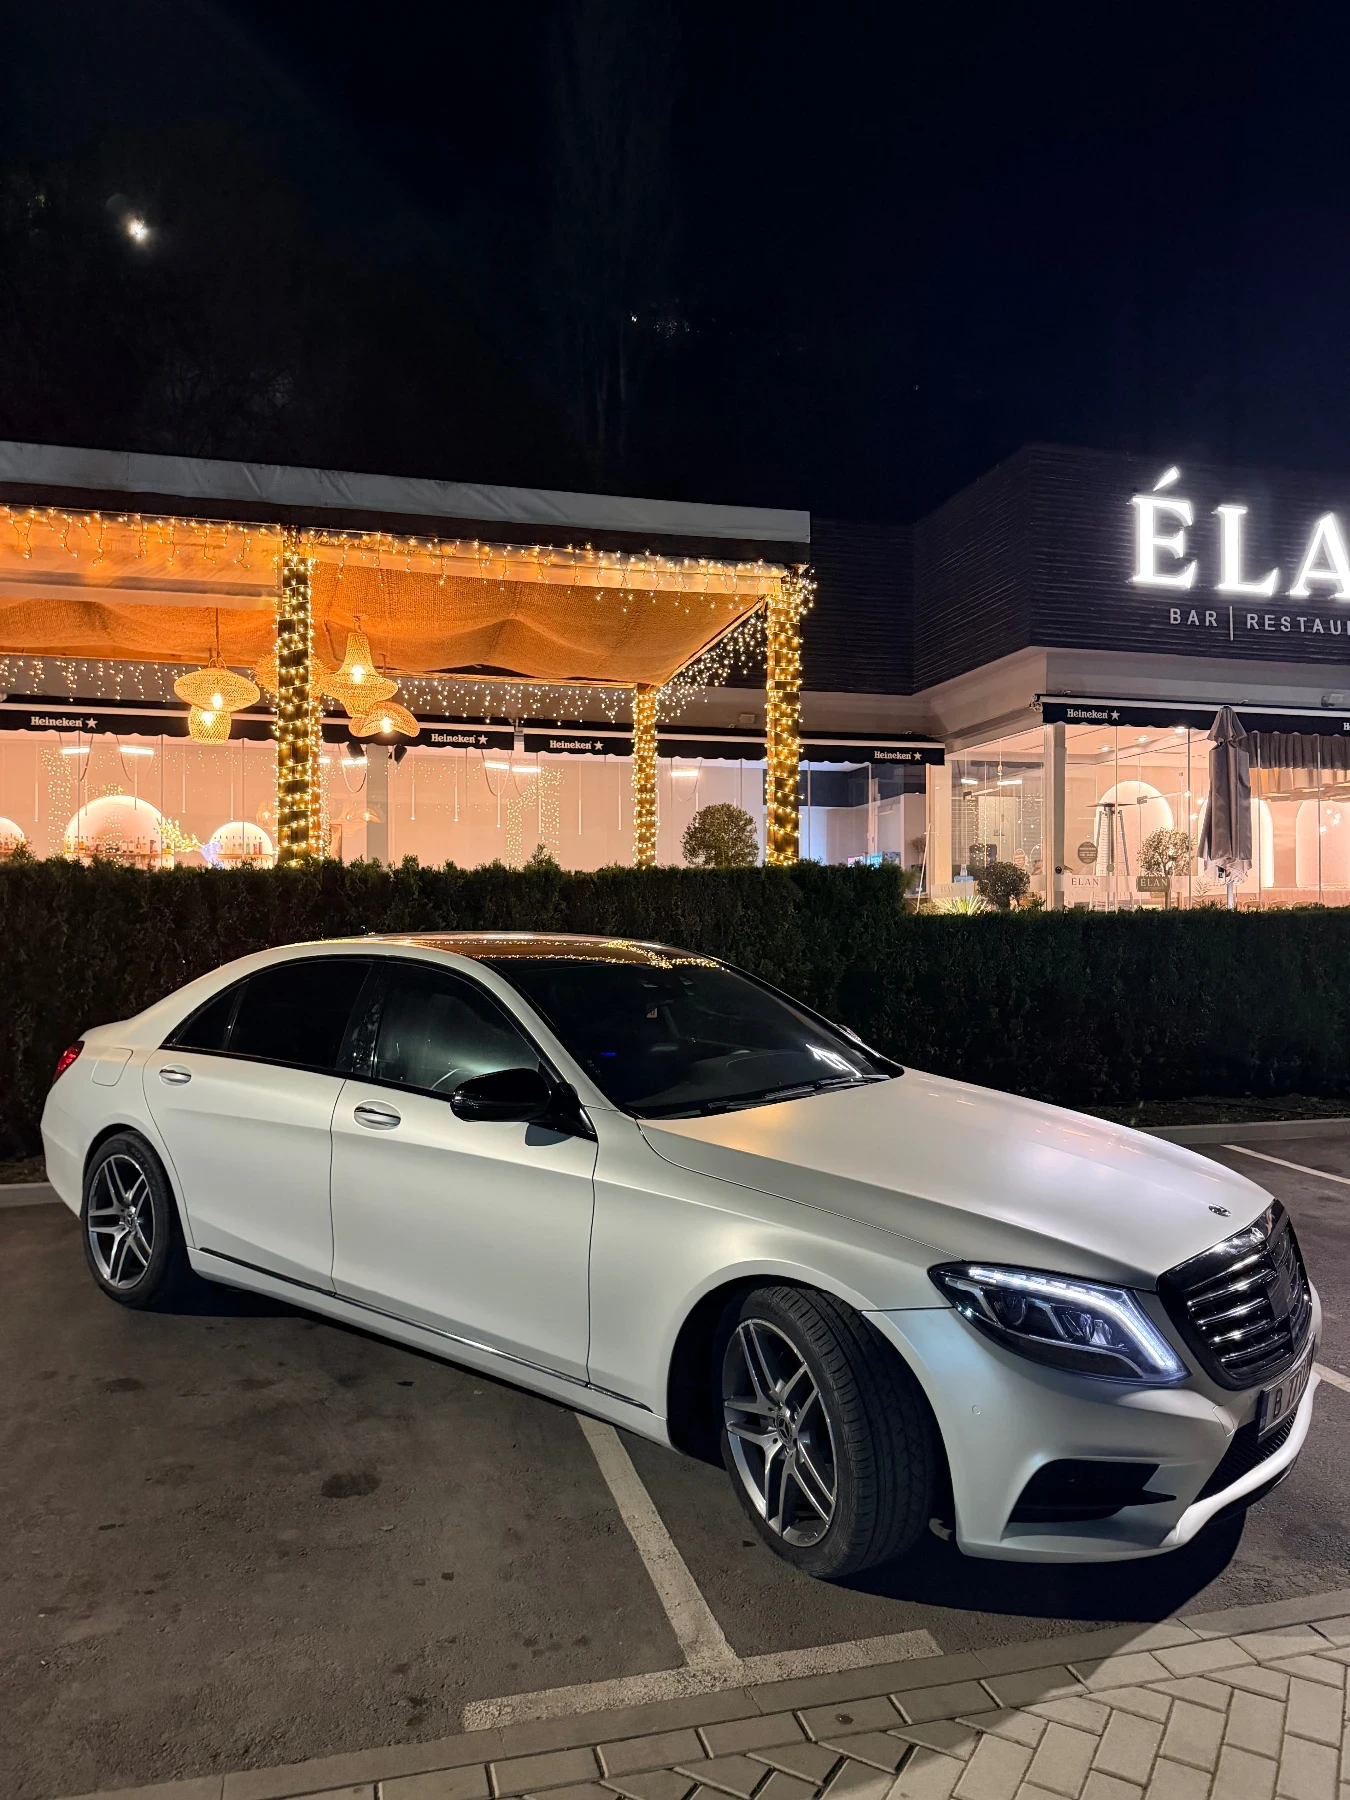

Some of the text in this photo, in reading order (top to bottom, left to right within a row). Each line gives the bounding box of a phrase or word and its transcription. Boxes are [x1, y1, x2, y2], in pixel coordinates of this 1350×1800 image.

[1169, 608, 1350, 636] BAR RESTAU
[1066, 708, 1108, 719] Heineken
[30, 716, 83, 727] Heineken
[431, 733, 476, 744] Heineken
[550, 740, 592, 750] Heineken
[873, 750, 912, 760] Heineken
